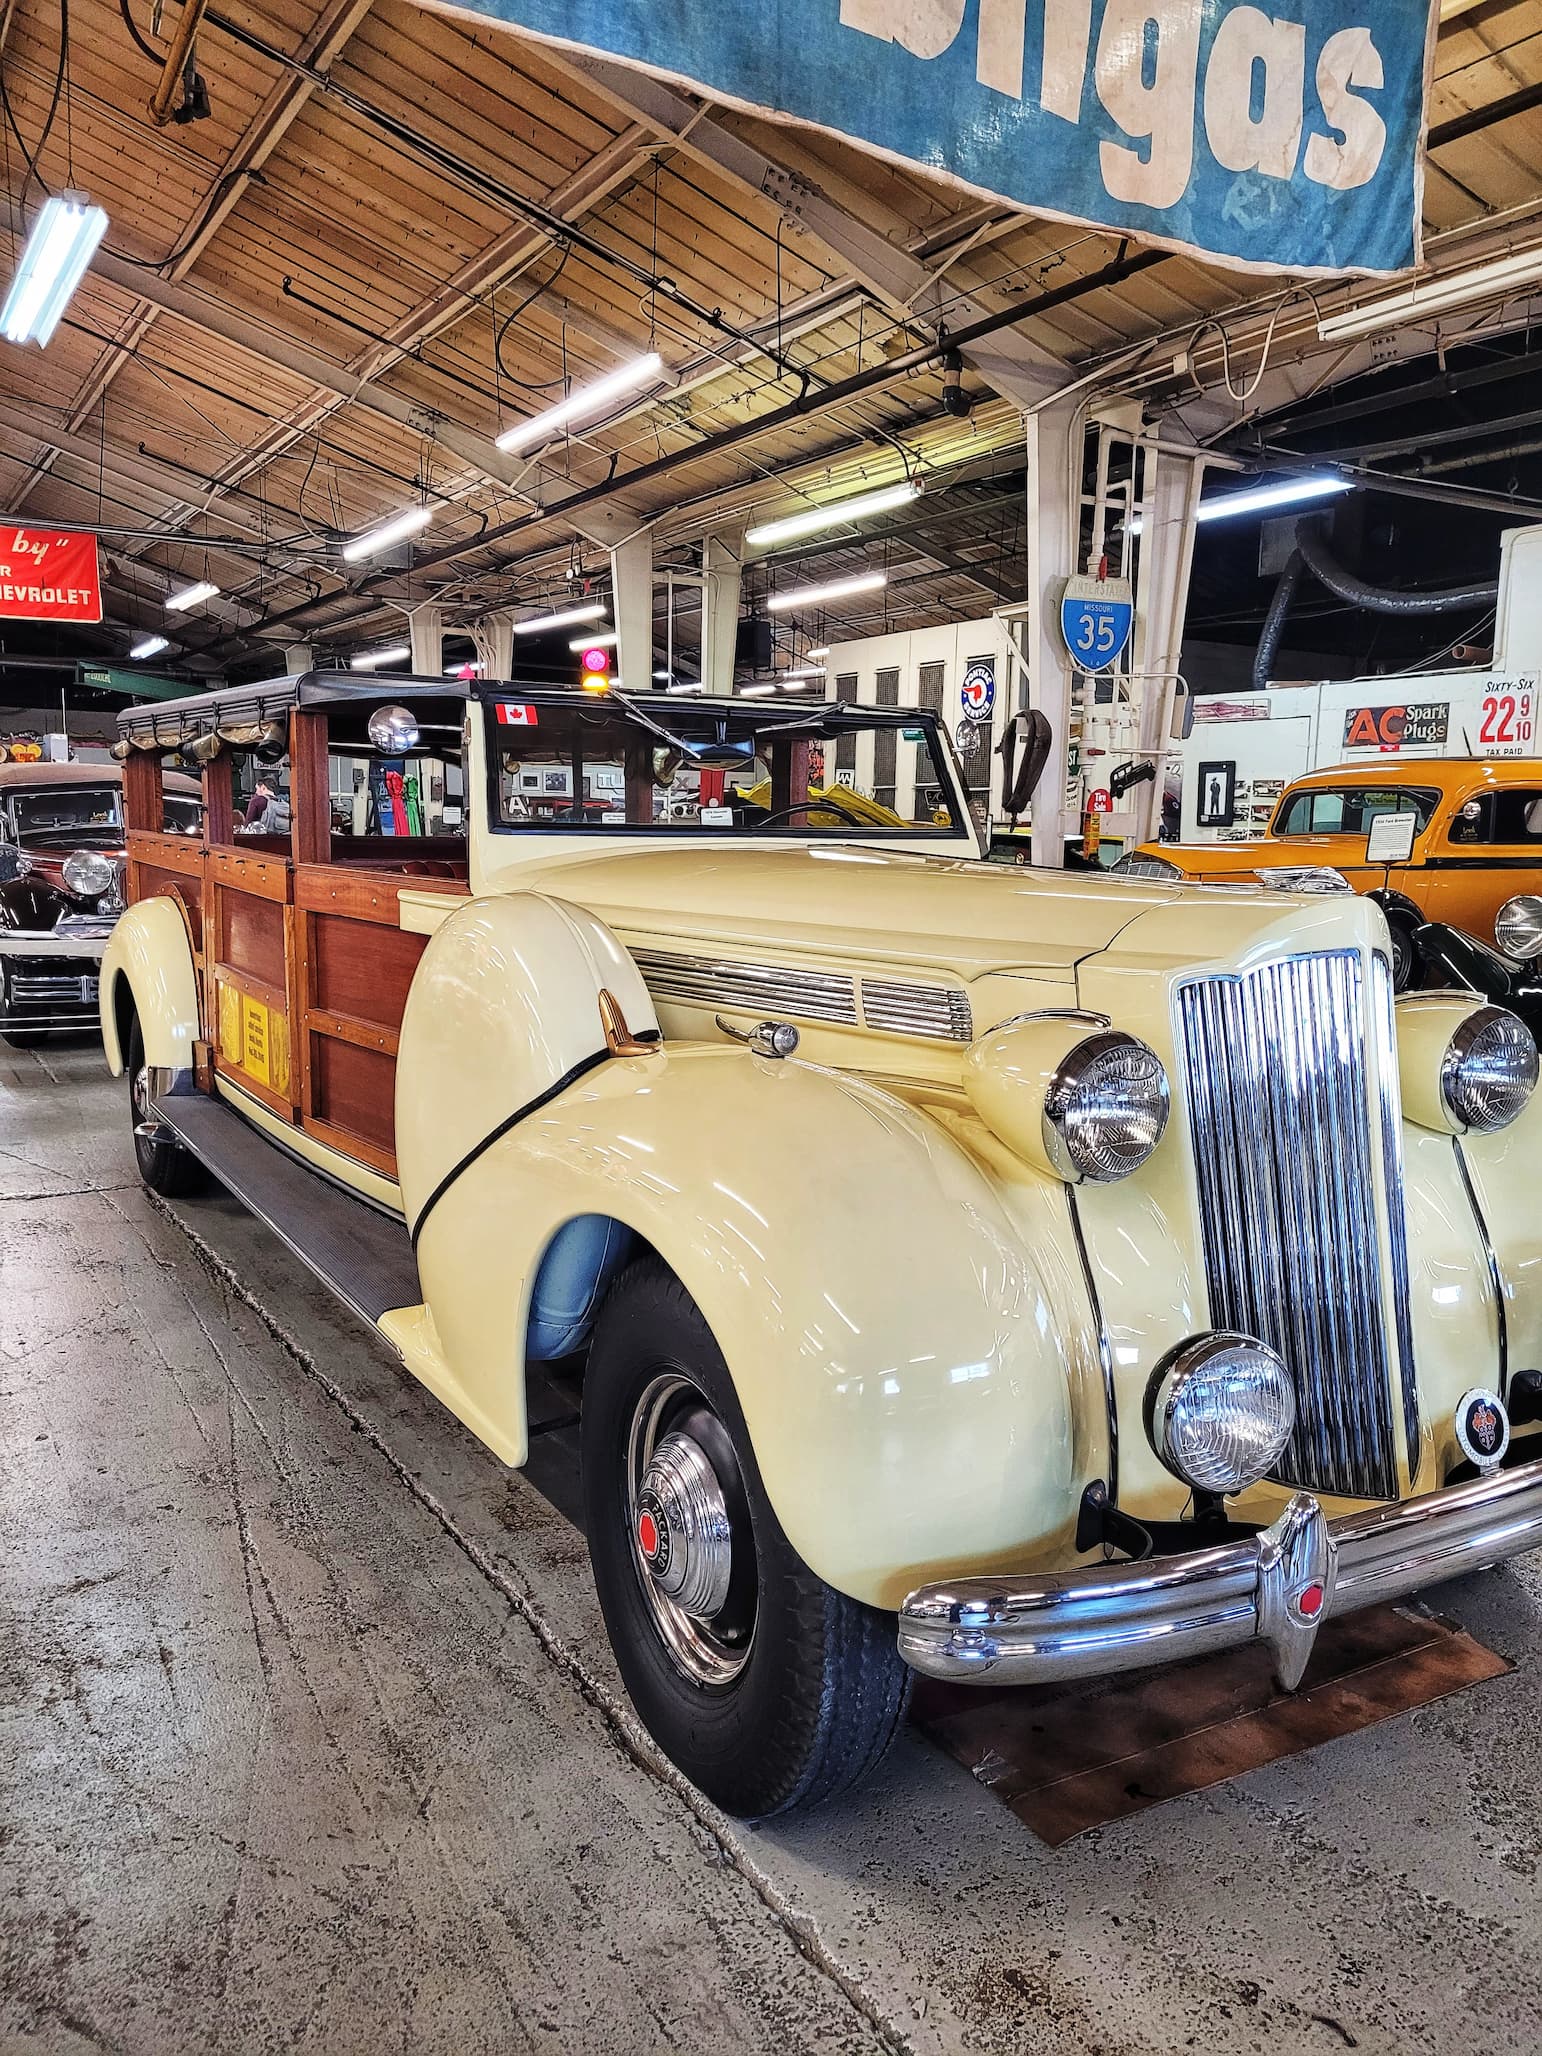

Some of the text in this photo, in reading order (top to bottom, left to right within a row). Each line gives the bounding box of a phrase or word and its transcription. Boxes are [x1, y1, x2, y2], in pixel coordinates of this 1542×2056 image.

[0, 584, 92, 606] EVROLET
[1073, 581, 1131, 597] INTERSTATE
[1084, 603, 1113, 613] MISSOURI
[1077, 614, 1115, 652] 35
[965, 668, 993, 686] PONTIAC
[1485, 678, 1535, 693] SIXTY-SIX
[963, 701, 990, 718] SERVICE
[1405, 704, 1448, 723] Spark
[1480, 695, 1516, 742] 22
[1347, 707, 1406, 744] AC
[1403, 722, 1446, 742] Plugs
[1486, 747, 1523, 756] TAX PAID
[1094, 793, 1106, 801] Tire
[1094, 802, 1107, 811] Sale
[651, 1503, 671, 1568] PACKARD
